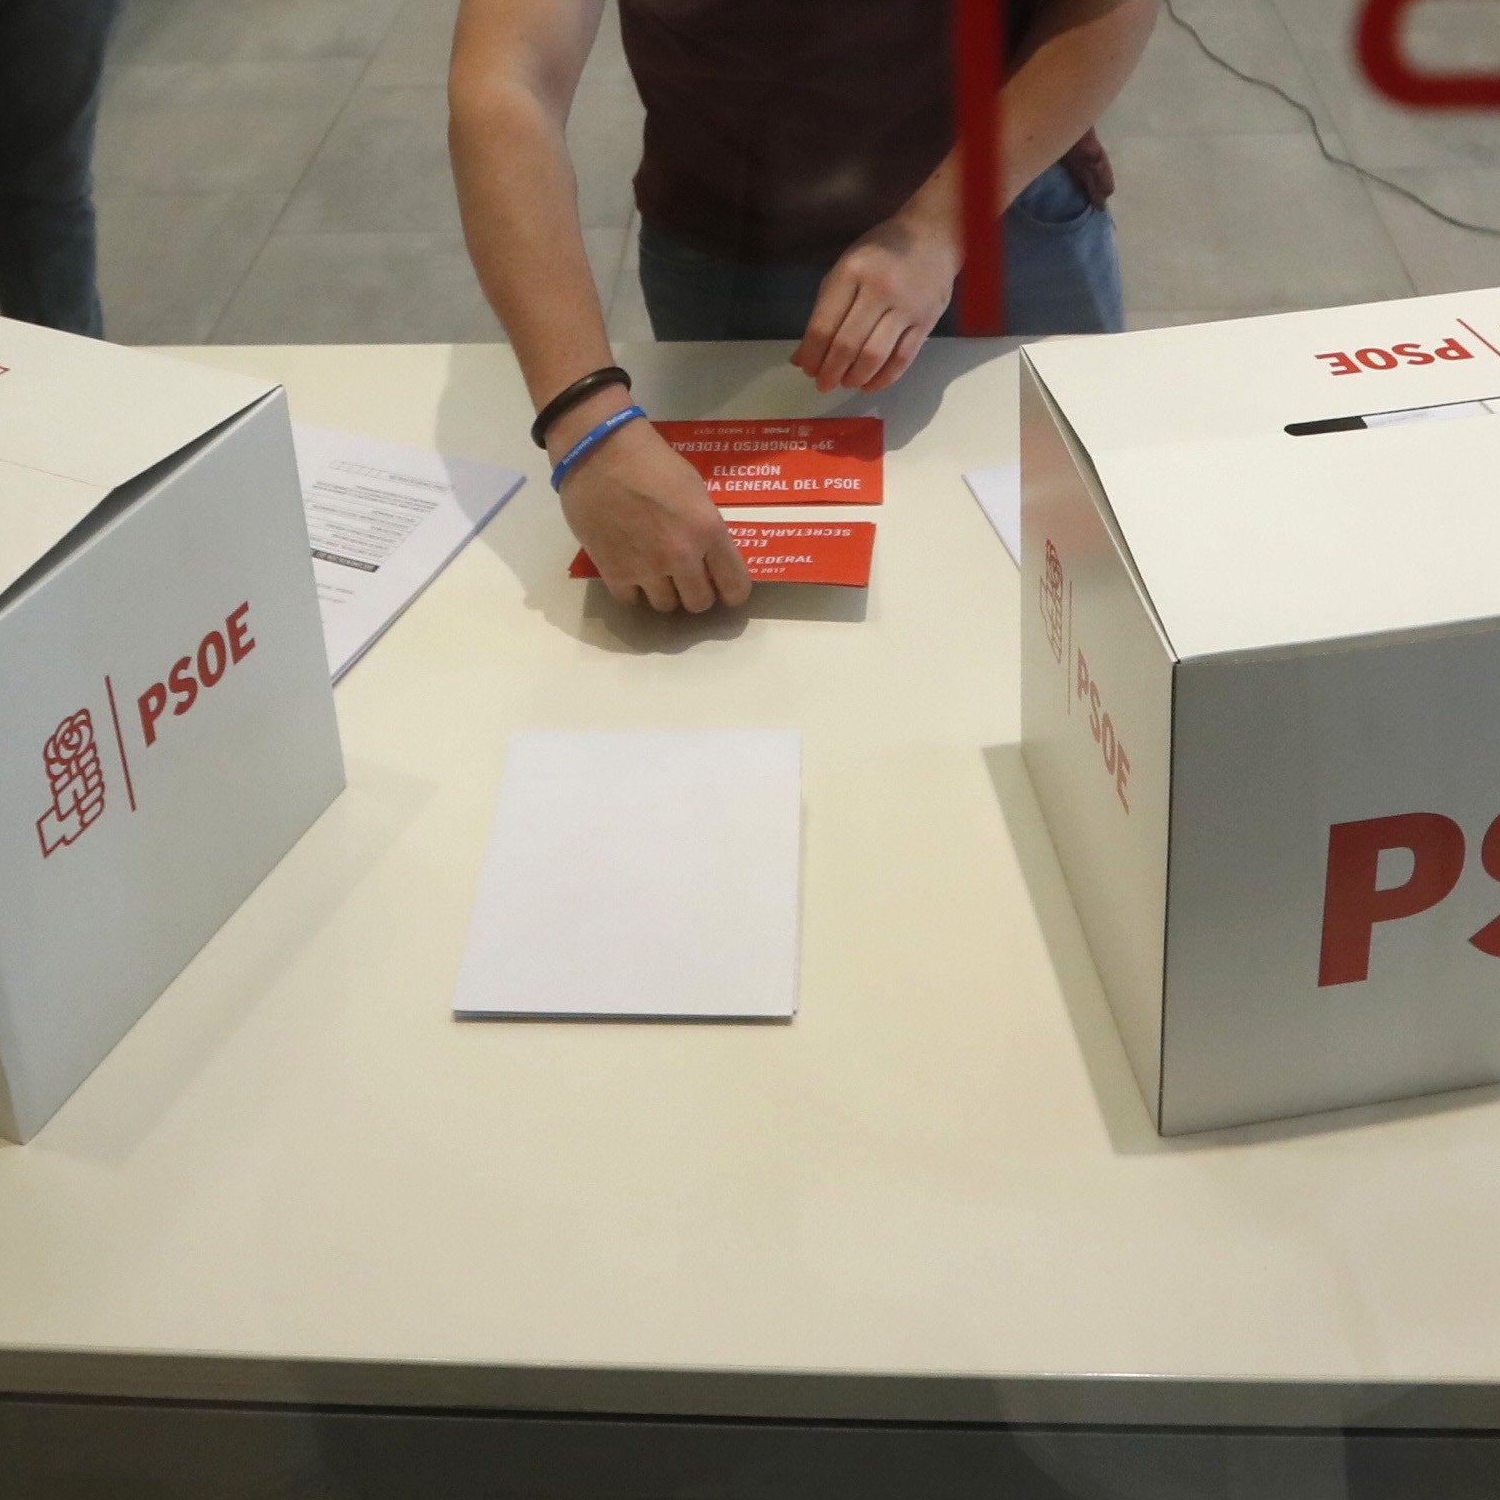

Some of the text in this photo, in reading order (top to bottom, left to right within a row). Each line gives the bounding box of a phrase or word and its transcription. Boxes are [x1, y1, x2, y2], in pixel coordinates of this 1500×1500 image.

[1315, 338, 1475, 376] PSOE
[734, 440, 808, 452] CONGRESO
[713, 465, 781, 476] ELECCIÓN
[725, 480, 789, 492] GENERAL
[794, 479, 819, 490] DEL
[824, 478, 861, 490] PSOE
[762, 528, 851, 537] SECRETARÍA
[747, 555, 814, 564] FEDERAL
[136, 601, 256, 747] PSOE
[1077, 648, 1131, 815] PSOE
